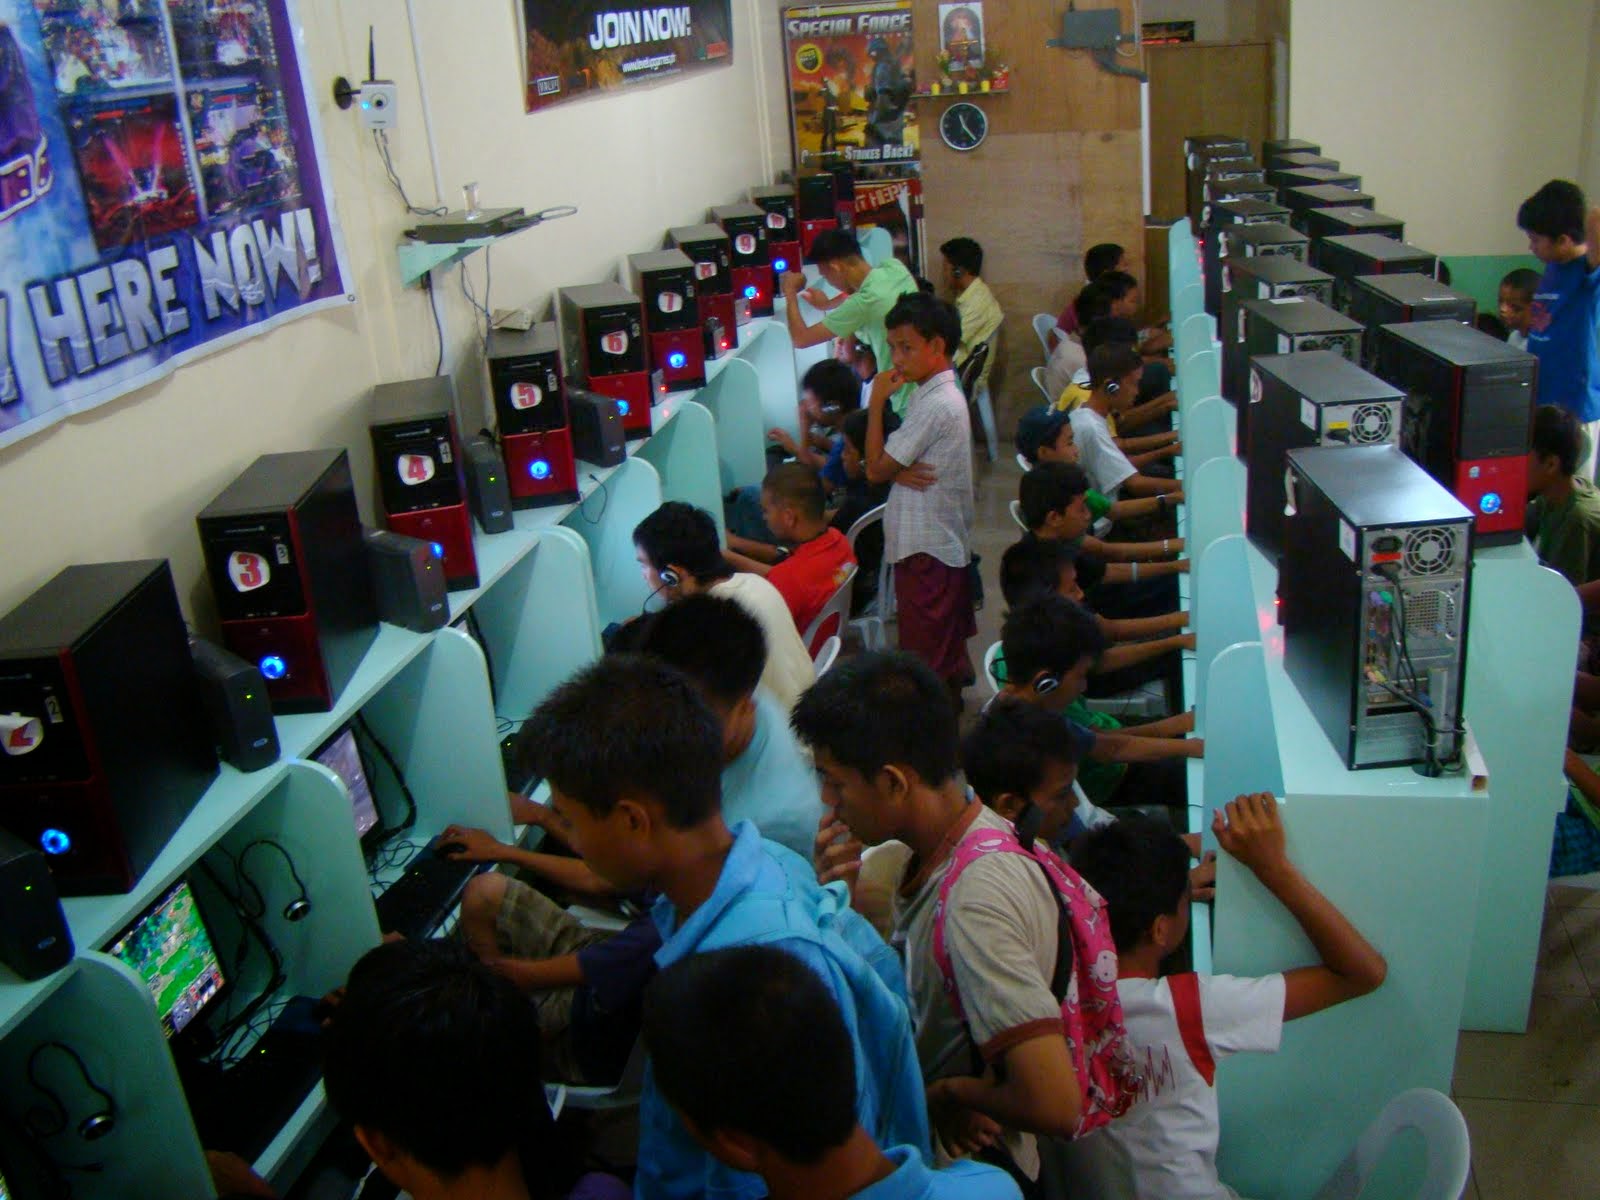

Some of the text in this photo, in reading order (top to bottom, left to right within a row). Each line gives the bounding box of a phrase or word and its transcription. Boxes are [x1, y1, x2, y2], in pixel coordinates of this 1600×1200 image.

[589, 7, 693, 50] JOIN NOW!
[786, 14, 912, 38] SPECIAL FORCE
[845, 145, 880, 160] STRIKES
[883, 143, 914, 158] BACK!
[28, 245, 190, 382] HERE
[192, 207, 323, 320] NOW!
[608, 331, 623, 352] 6
[516, 383, 536, 407] 5
[408, 455, 428, 481] 4
[237, 552, 262, 588] 3
